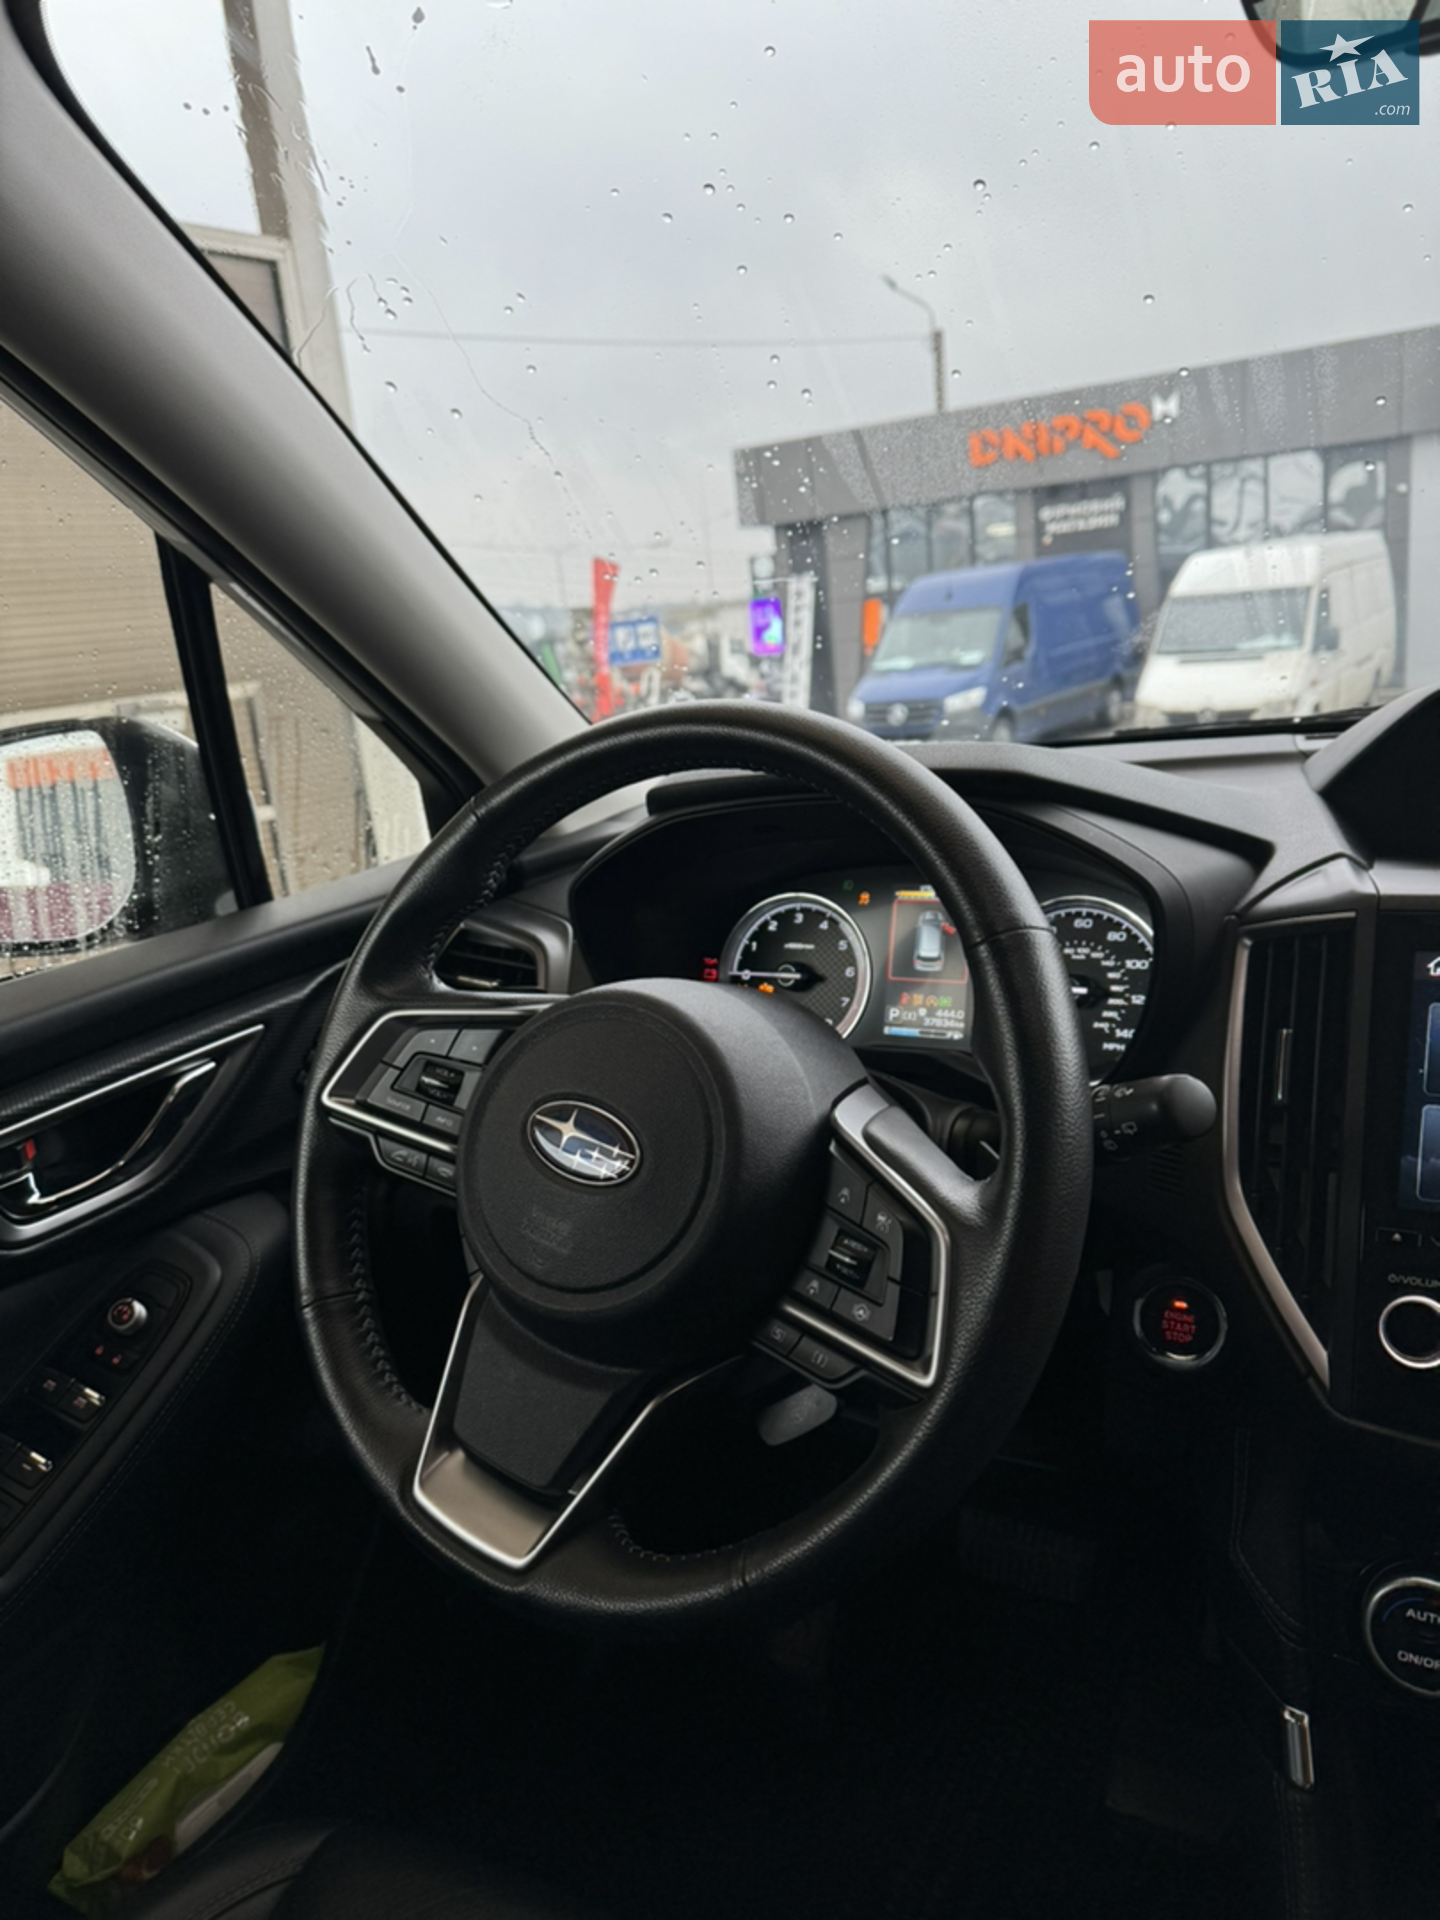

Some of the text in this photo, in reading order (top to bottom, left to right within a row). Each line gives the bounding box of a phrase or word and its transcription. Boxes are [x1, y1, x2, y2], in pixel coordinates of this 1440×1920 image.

[794, 912, 804, 924] 3
[1073, 918, 1093, 929] 60
[768, 920, 778, 931] 2
[818, 920, 829, 930] 4
[1106, 930, 1127, 942] 80
[751, 941, 758, 952] 1
[838, 940, 848, 950] 5
[1125, 959, 1149, 970] 100
[844, 966, 855, 978] 6
[1131, 995, 1146, 1005] 12
